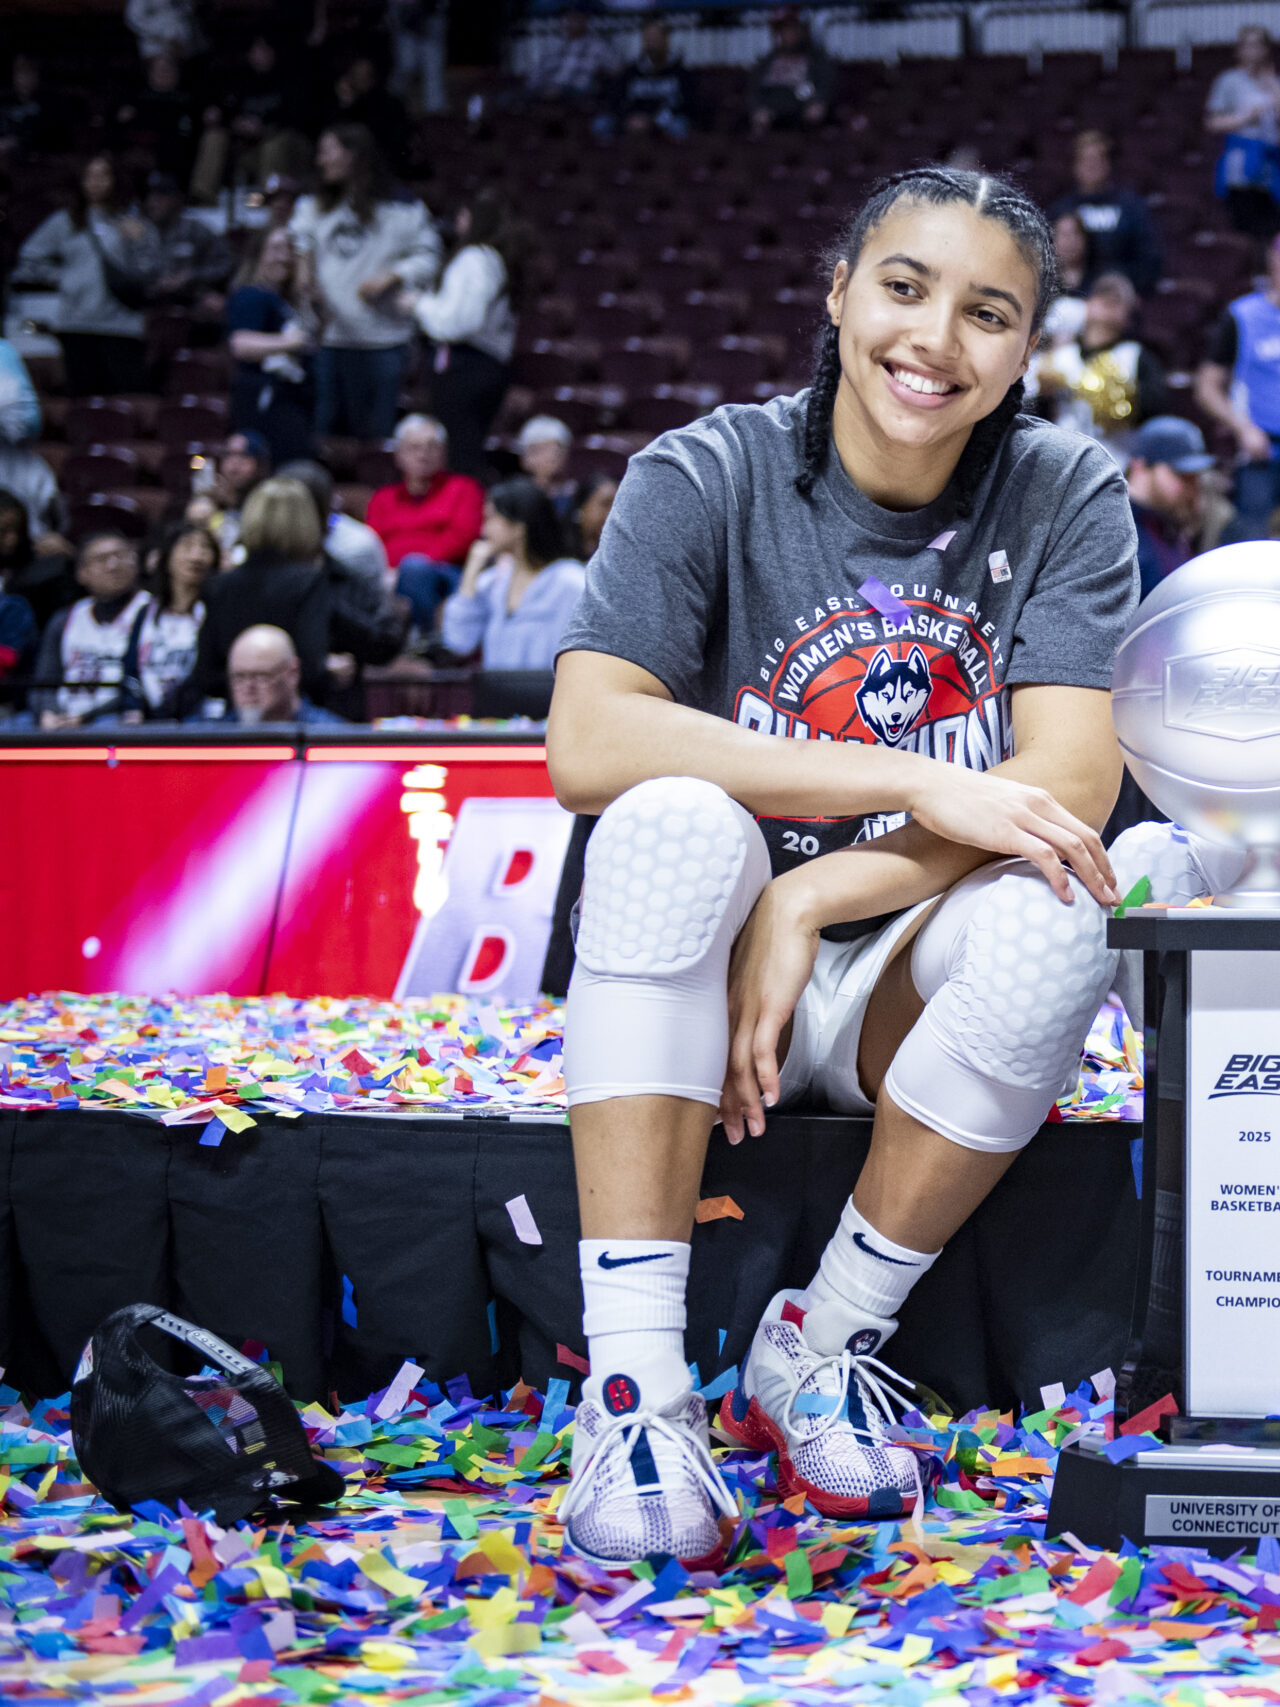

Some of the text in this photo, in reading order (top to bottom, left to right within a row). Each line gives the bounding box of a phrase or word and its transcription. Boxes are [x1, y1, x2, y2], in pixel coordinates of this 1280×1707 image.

[760, 583, 1004, 682] BIG EAST OURNAENT
[778, 613, 988, 703] WOMEN'S BASKETBALL
[1238, 1131, 1272, 1142] 2025
[1170, 1502, 1259, 1517] UNIVERSITY
[1171, 1519, 1280, 1535] CONNECTICUT
